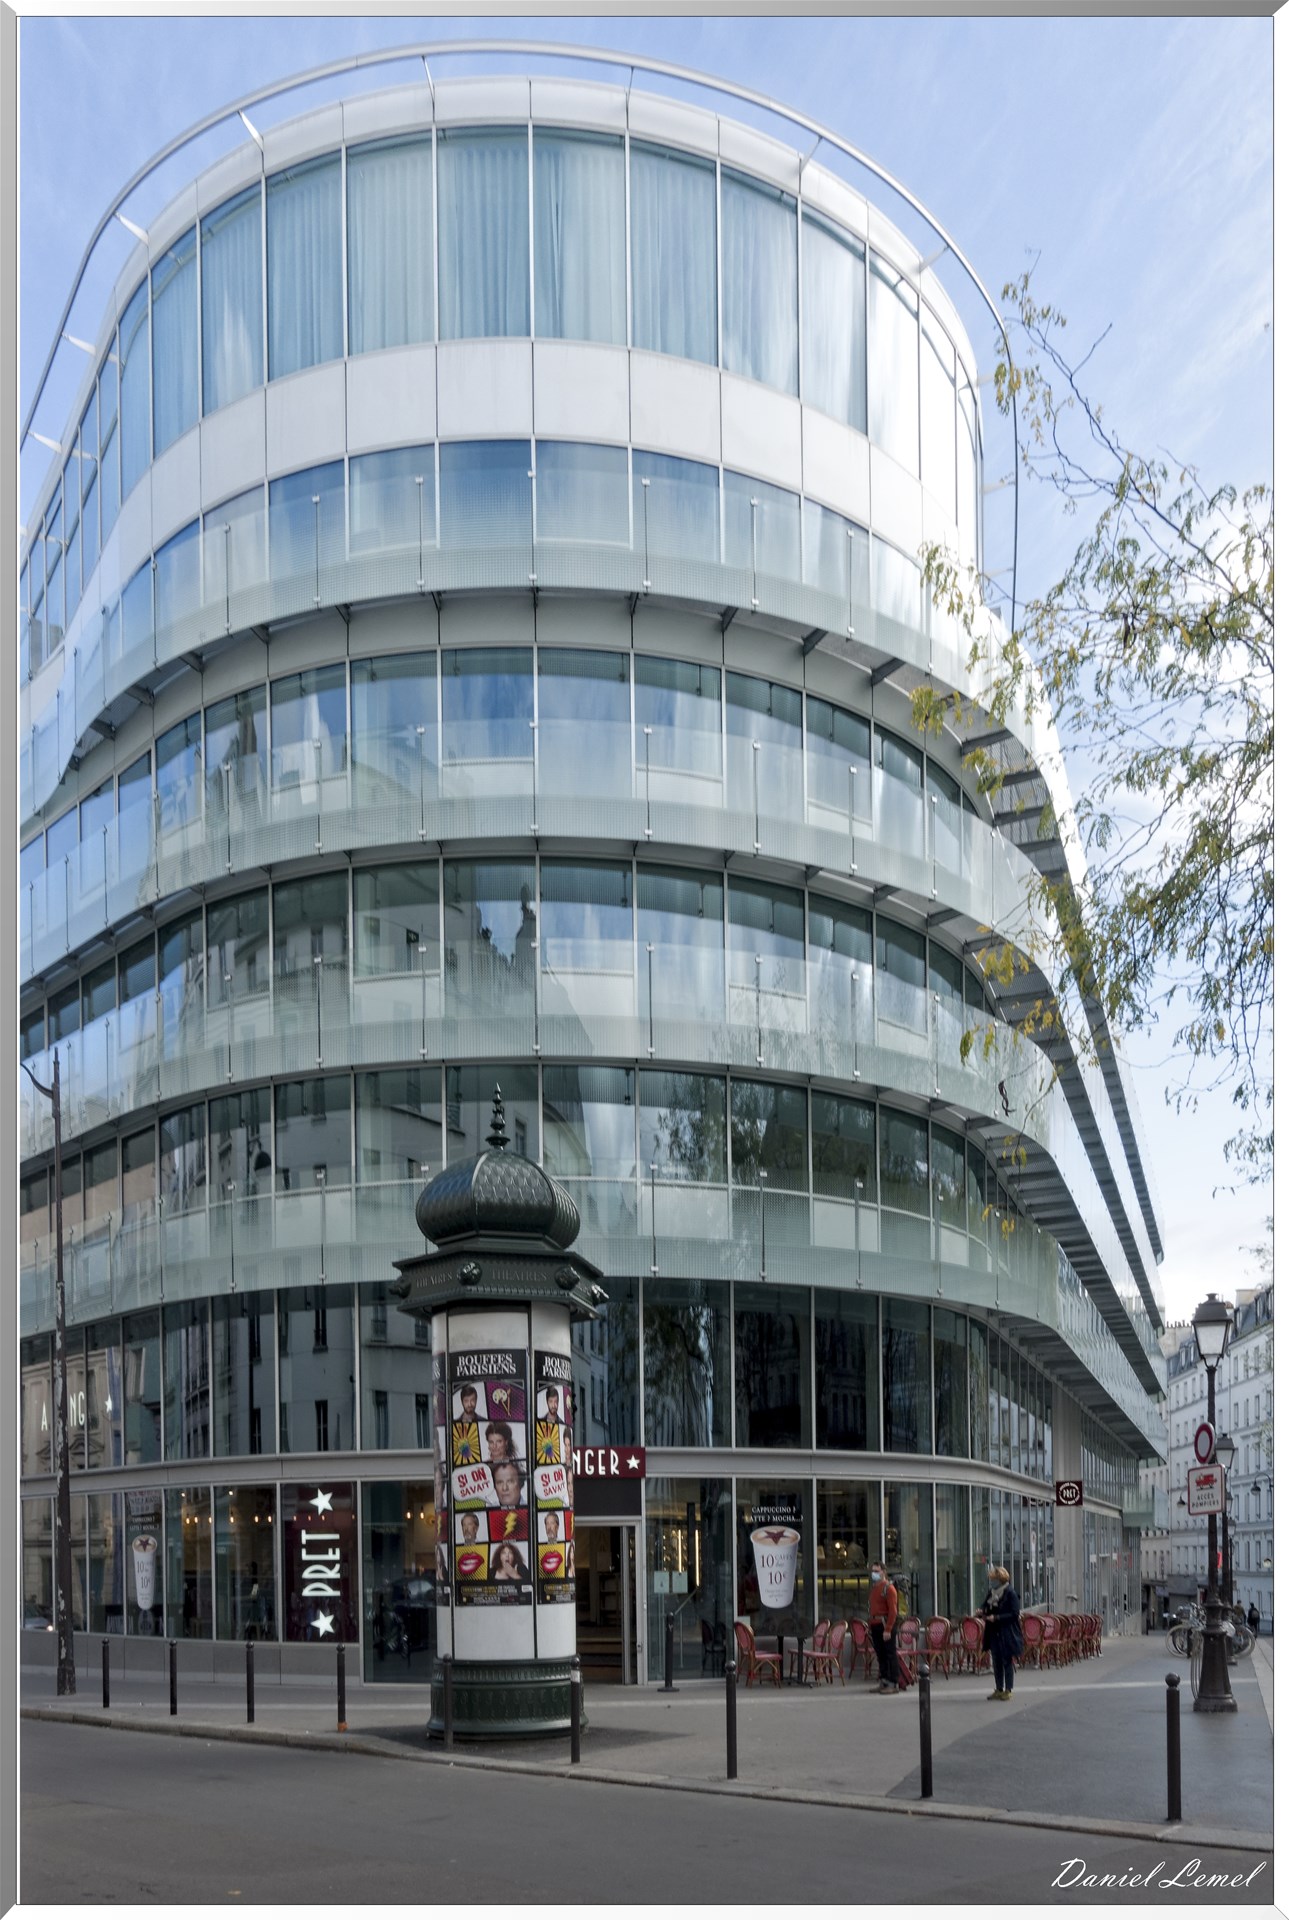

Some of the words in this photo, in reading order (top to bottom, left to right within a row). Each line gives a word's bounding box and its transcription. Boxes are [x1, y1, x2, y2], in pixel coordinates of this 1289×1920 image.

[458, 1353, 513, 1366] BOUFFES
[456, 1363, 517, 1377] PARISIENS
[458, 1473, 468, 1488] SI
[471, 1467, 487, 1482] ON
[541, 1473, 551, 1487] SI
[553, 1468, 564, 1481] ON
[460, 1481, 491, 1498] SAVAIT
[301, 1529, 341, 1597] PRET
[761, 1554, 775, 1568] 10
